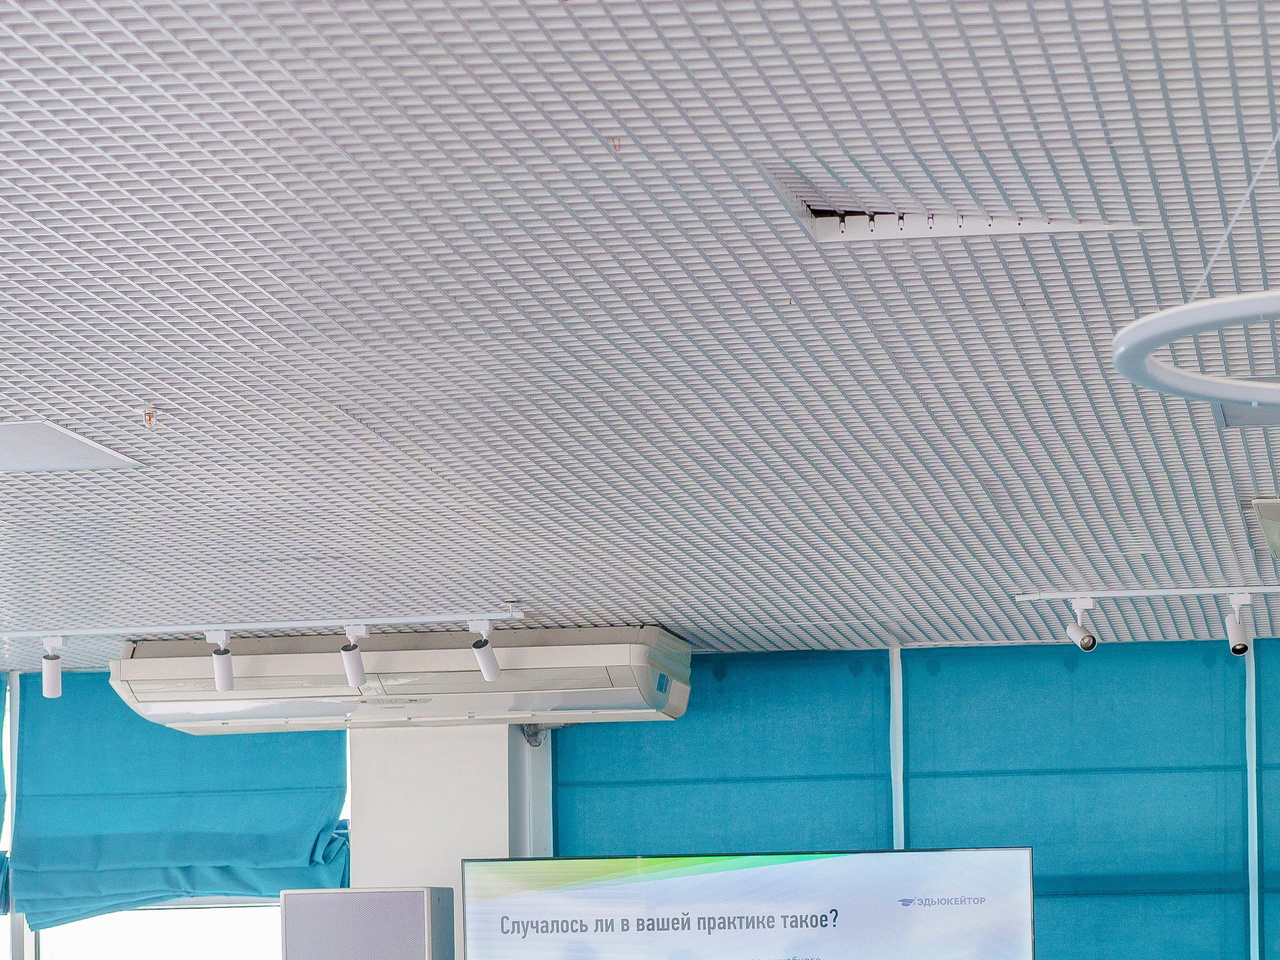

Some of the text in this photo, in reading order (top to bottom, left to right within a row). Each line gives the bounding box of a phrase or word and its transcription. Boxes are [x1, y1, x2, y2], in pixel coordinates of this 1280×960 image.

[917, 896, 986, 907] ЭДЬЮКЕЙТОР
[500, 908, 838, 939] Случалось ли в вашей практике такое?
